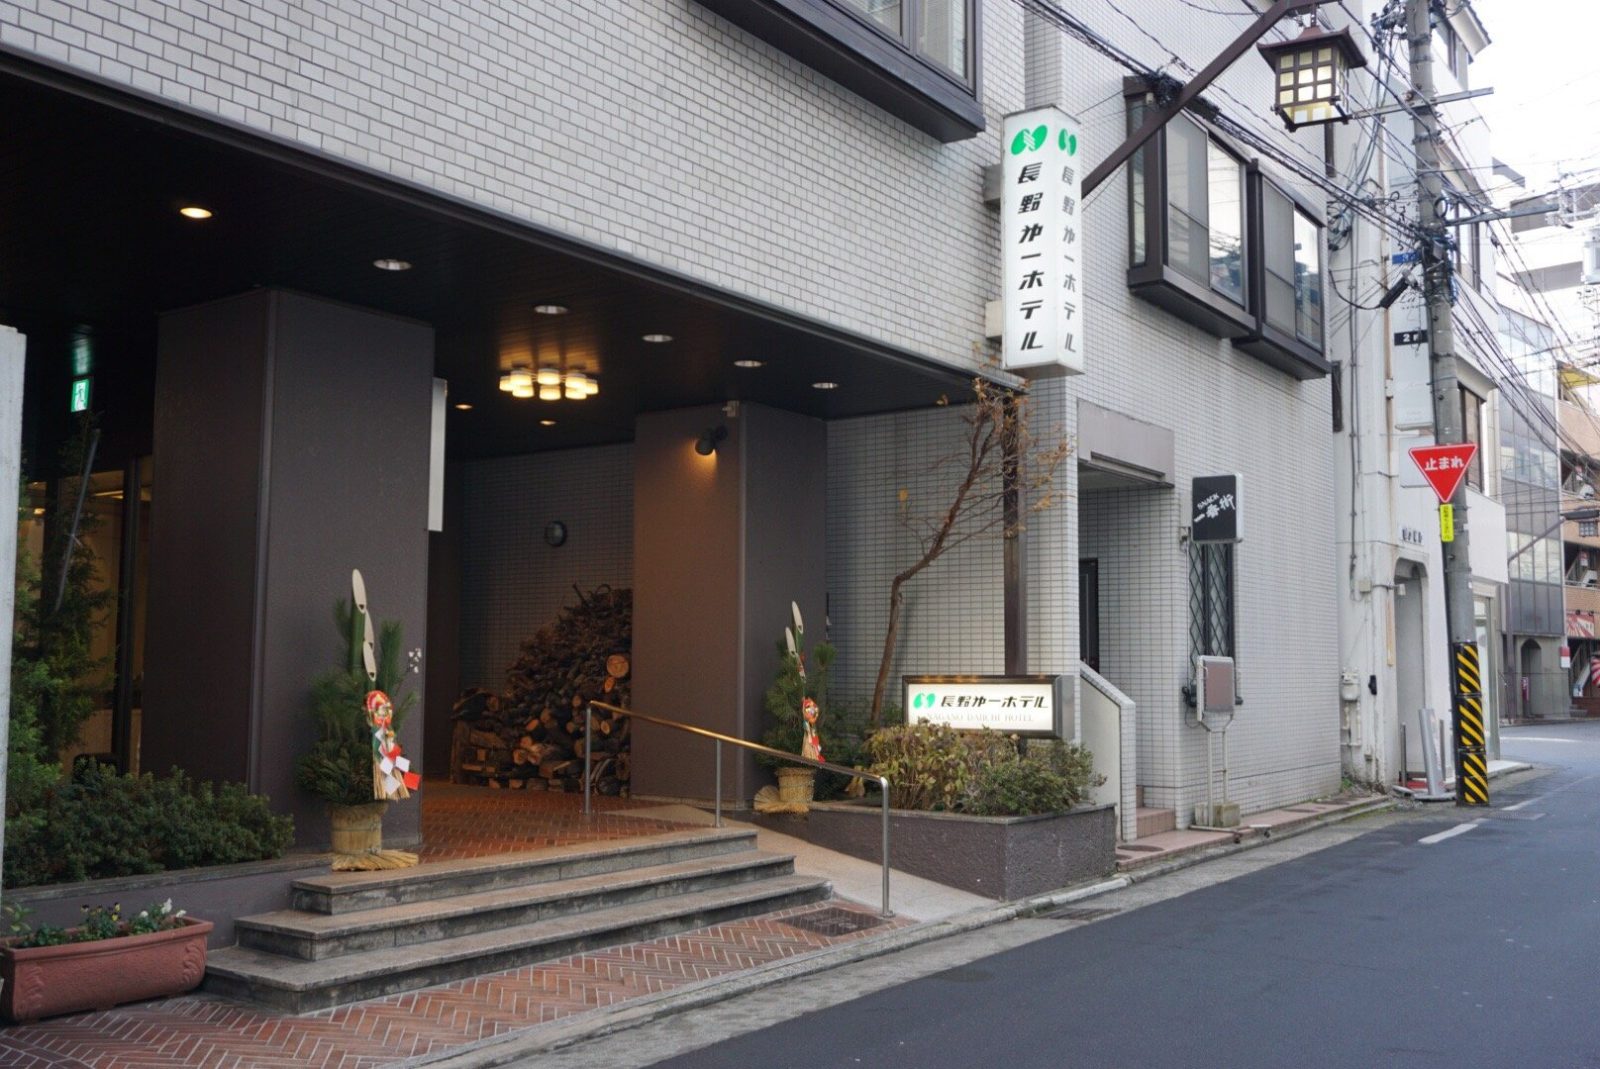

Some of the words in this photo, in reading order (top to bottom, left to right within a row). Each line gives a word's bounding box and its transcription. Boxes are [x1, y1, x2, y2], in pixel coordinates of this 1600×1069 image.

[1425, 456, 1464, 471] 止まれ
[927, 713, 964, 722] NAGANO
[1004, 713, 1034, 722] HOTEL
